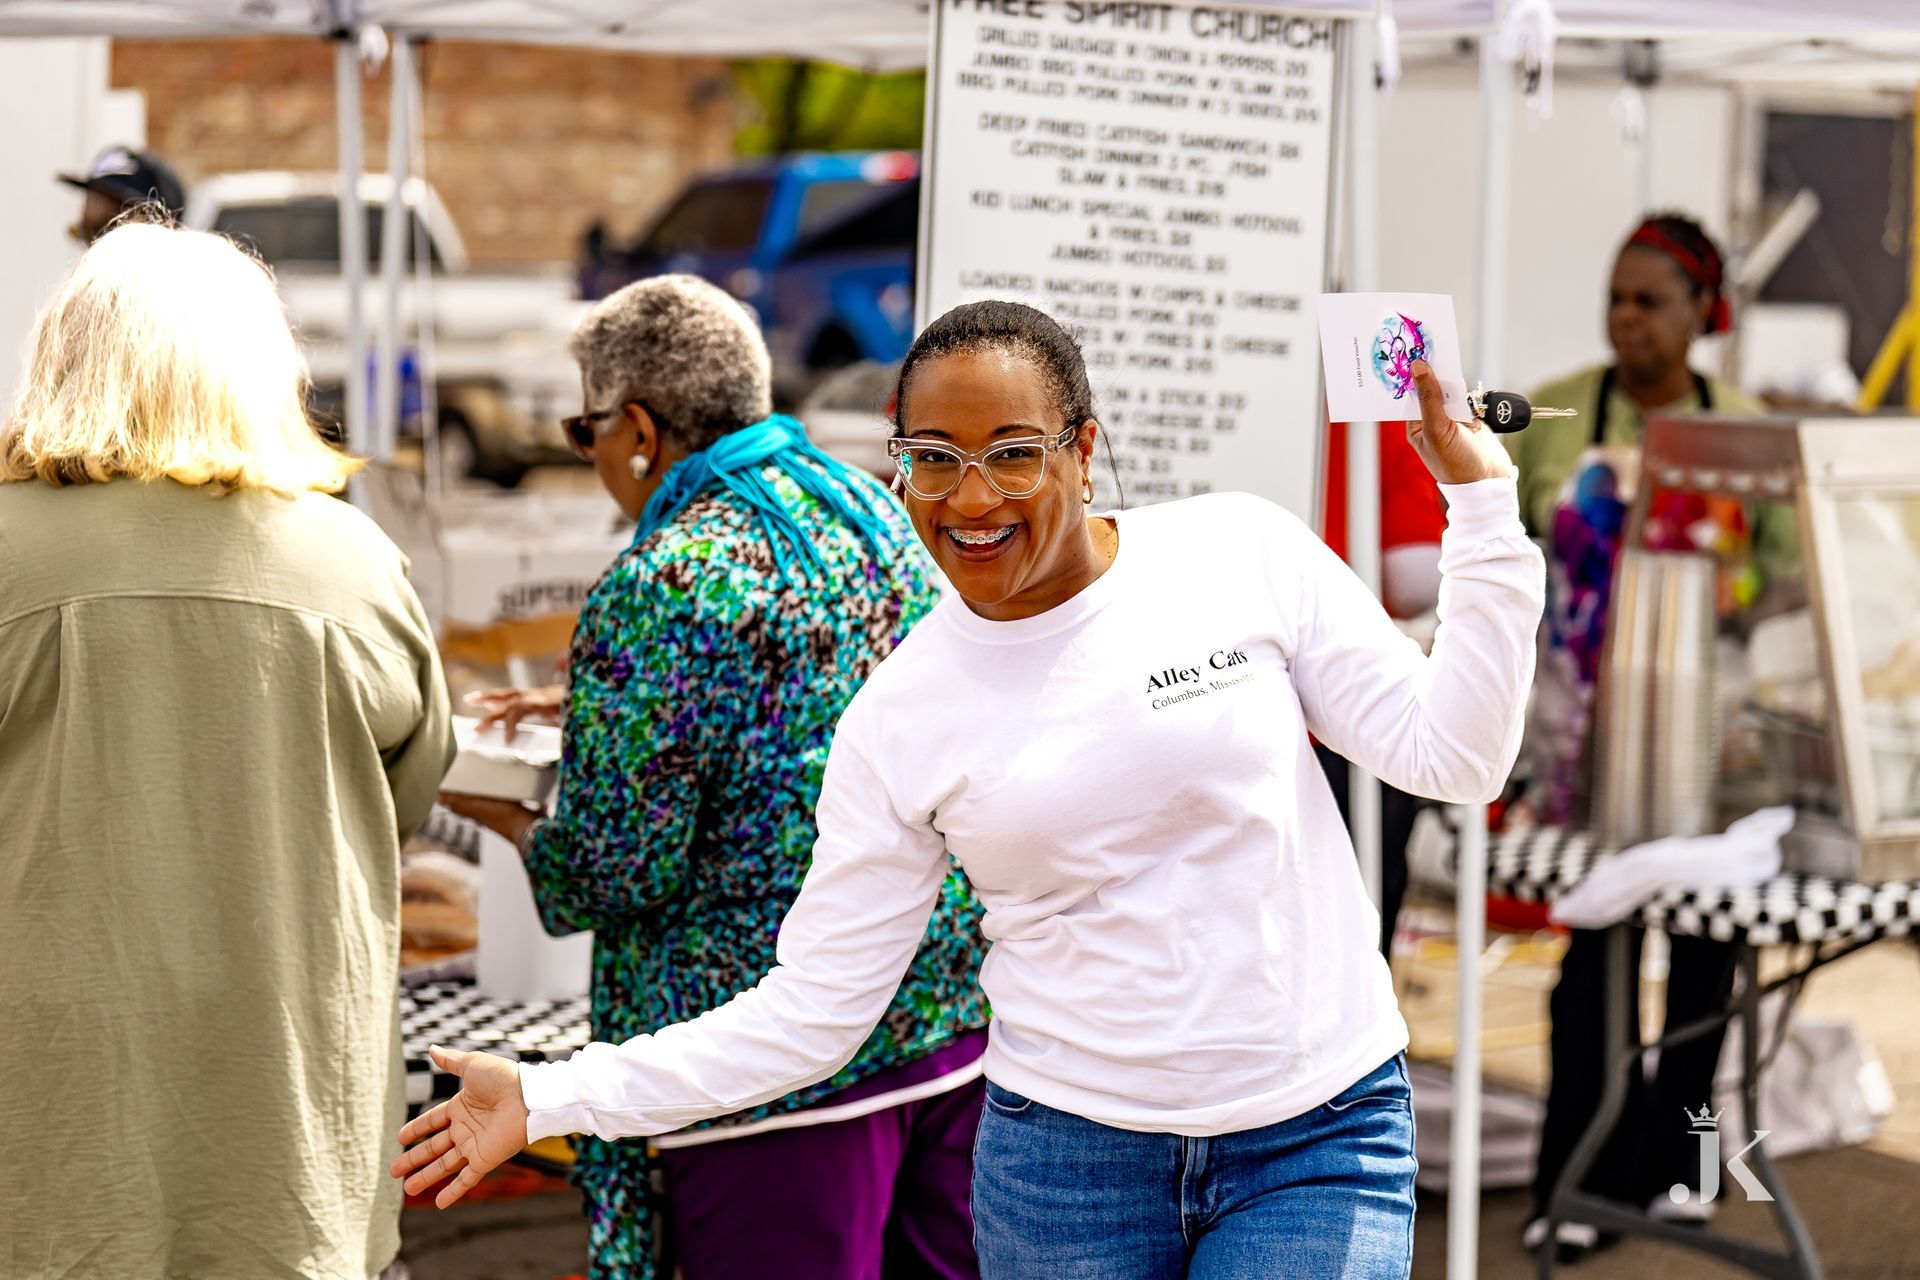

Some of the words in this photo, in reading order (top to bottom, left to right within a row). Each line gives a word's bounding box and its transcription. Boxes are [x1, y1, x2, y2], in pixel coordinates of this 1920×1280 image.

[1064, 0, 1173, 31] SPIRIT
[1190, 7, 1330, 48] CHURCH
[1050, 35, 1117, 55] SAUSAGE
[974, 51, 1031, 71] JUMBO
[1042, 58, 1075, 76] BBQ
[1085, 63, 1144, 83] PULLED
[1157, 71, 1196, 87] PORK
[959, 72, 993, 90] BBQ
[1005, 76, 1066, 96] PULLED
[1077, 84, 1119, 100] PORK
[1130, 90, 1188, 108] DINNER
[979, 113, 1027, 132] DEEP
[1036, 118, 1087, 139] FRIED
[1099, 124, 1168, 144] CATFISH
[1011, 139, 1086, 160] CATFISH
[1096, 149, 1159, 166] DINNER
[1231, 160, 1267, 177] FISH
[1058, 166, 1106, 184] SLAW
[971, 190, 1000, 208] KID
[1010, 194, 1071, 213] LUNCH
[1082, 200, 1150, 220] SPECIAL
[1166, 208, 1220, 226] JUMBO
[1051, 245, 1112, 263] JUMBO
[959, 271, 1033, 290] LOADED
[1044, 278, 1119, 297] NACHOS
[1153, 286, 1205, 304] CHIPS
[1233, 291, 1301, 312] CHEESE
[1055, 304, 1118, 321] PULLED
[1145, 332, 1193, 349] FRIES
[1223, 335, 1289, 356] CHEESE
[1146, 666, 1201, 693] Alley
[1209, 648, 1248, 670] Cats
[1152, 687, 1209, 710] Columbus,
